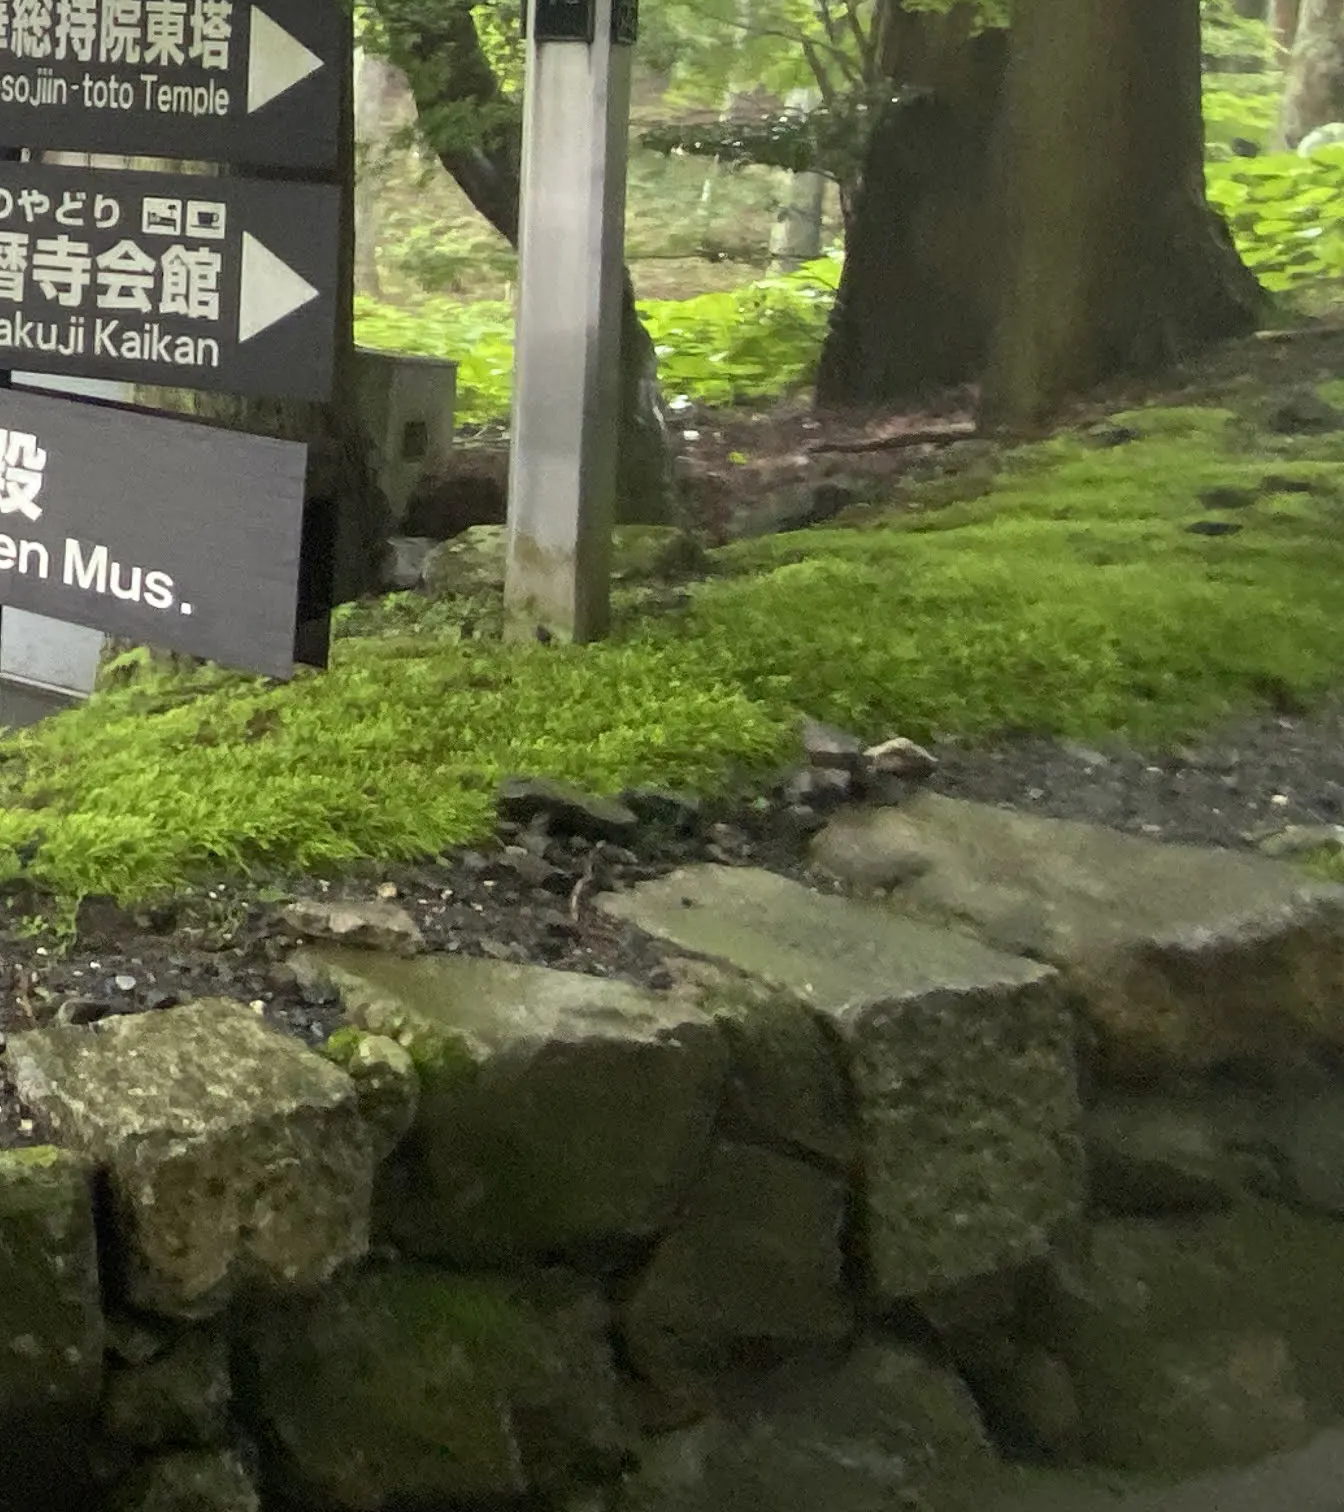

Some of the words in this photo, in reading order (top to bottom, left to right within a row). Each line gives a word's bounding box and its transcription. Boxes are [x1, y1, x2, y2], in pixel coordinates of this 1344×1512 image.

[141, 74, 231, 117] Temple
[94, 322, 220, 367] Kaikan
[63, 538, 194, 616] Mus.
